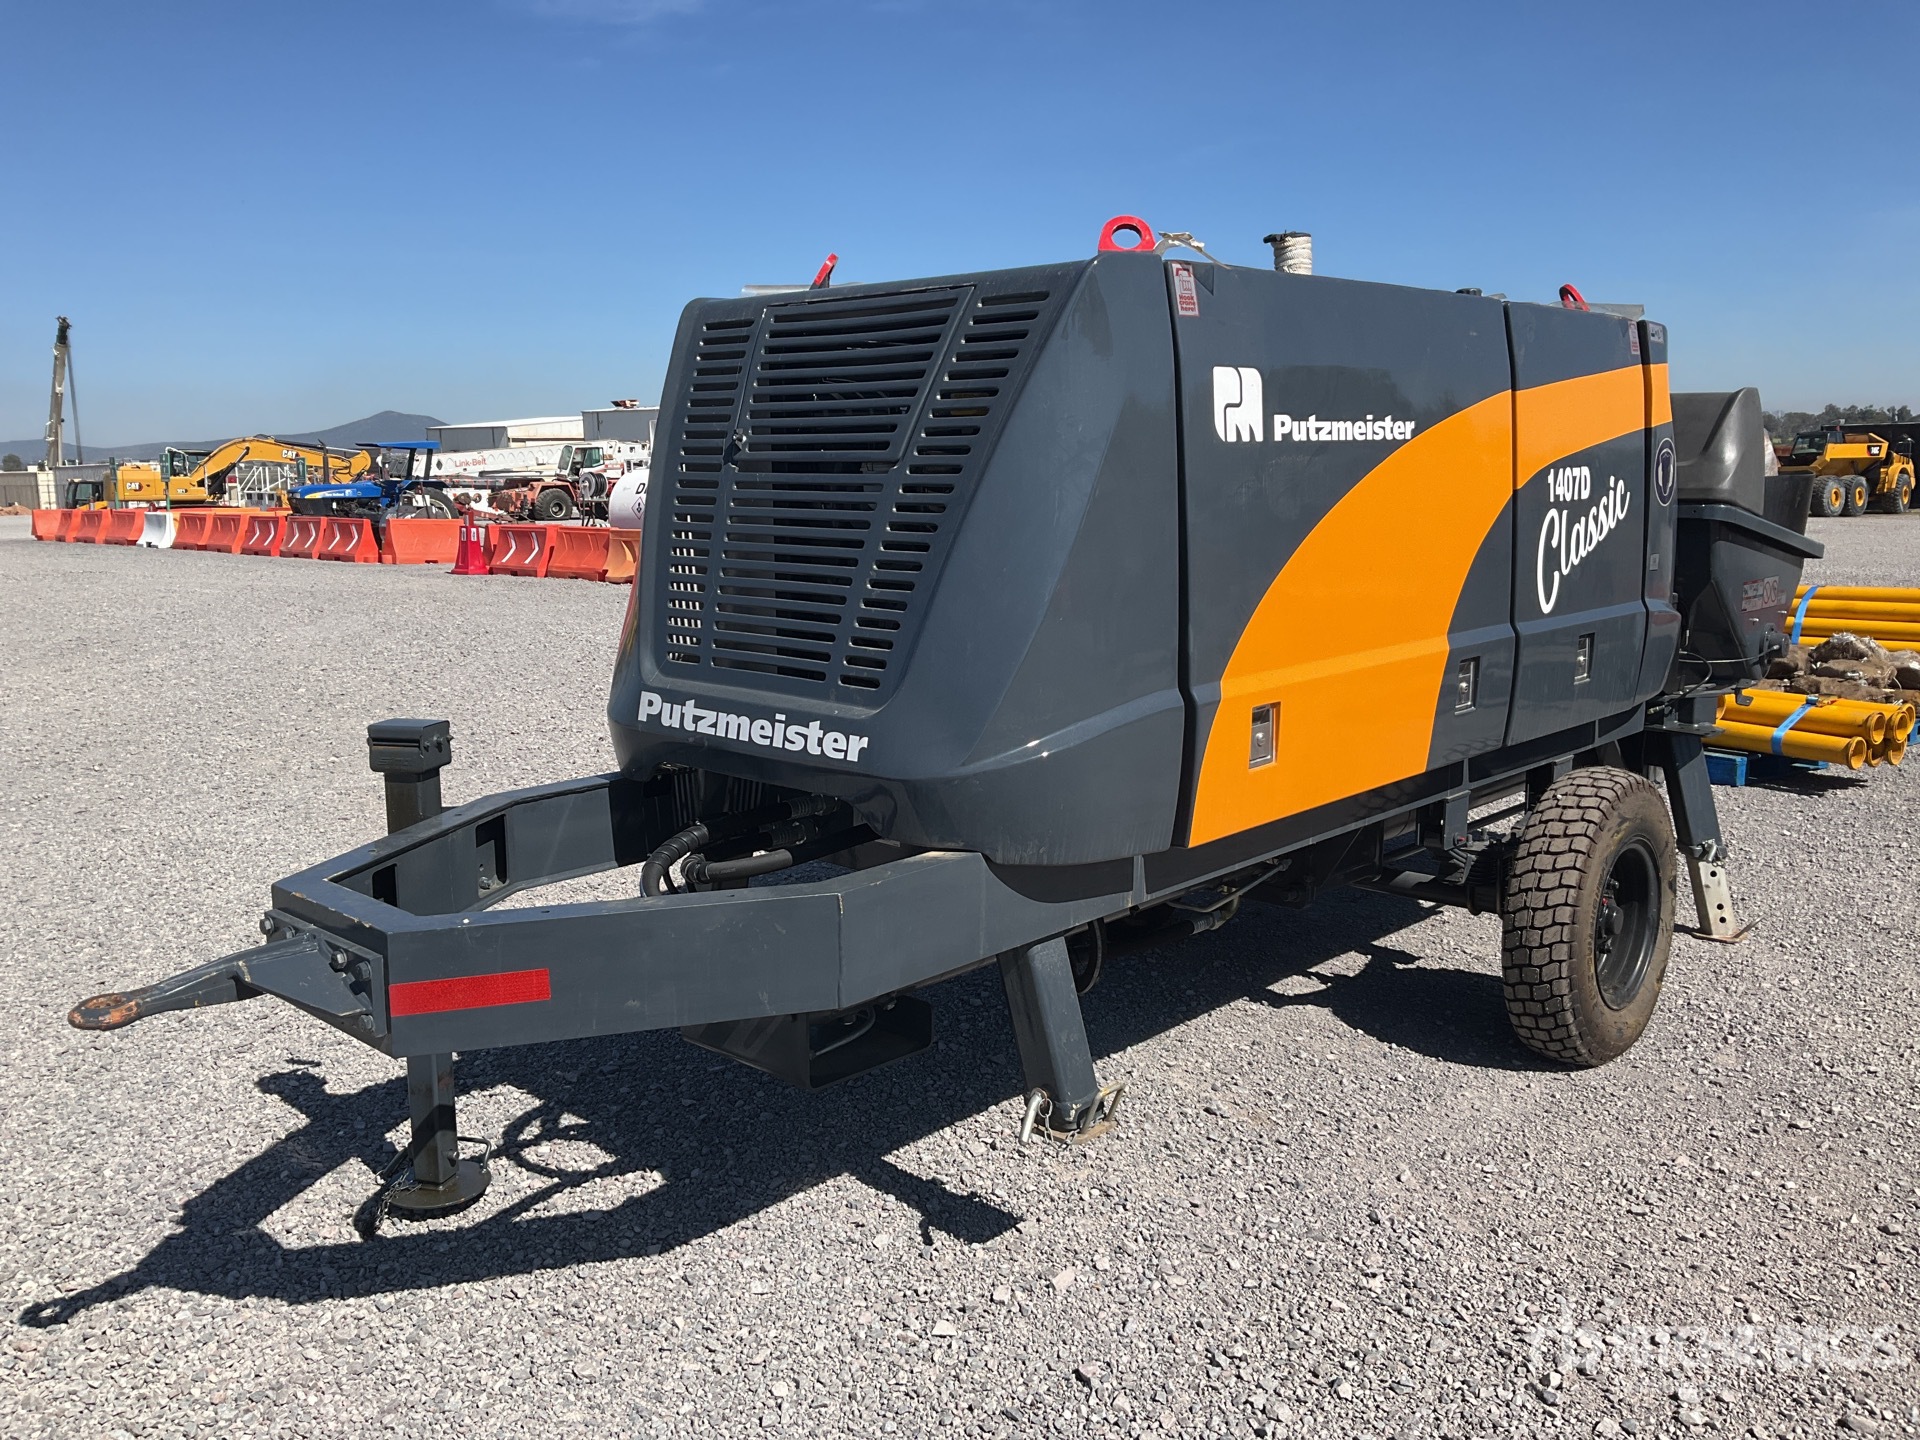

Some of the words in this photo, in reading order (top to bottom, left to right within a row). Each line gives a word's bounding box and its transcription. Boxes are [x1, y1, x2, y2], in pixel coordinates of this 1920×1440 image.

[1273, 414, 1416, 442] Putzmeister
[282, 449, 297, 459] CAT
[455, 457, 487, 468] Link-Belt
[126, 482, 140, 490] CAT
[1548, 466, 1591, 502] 1407D
[1537, 475, 1631, 614] Classic
[637, 690, 869, 762] Putzmeister
